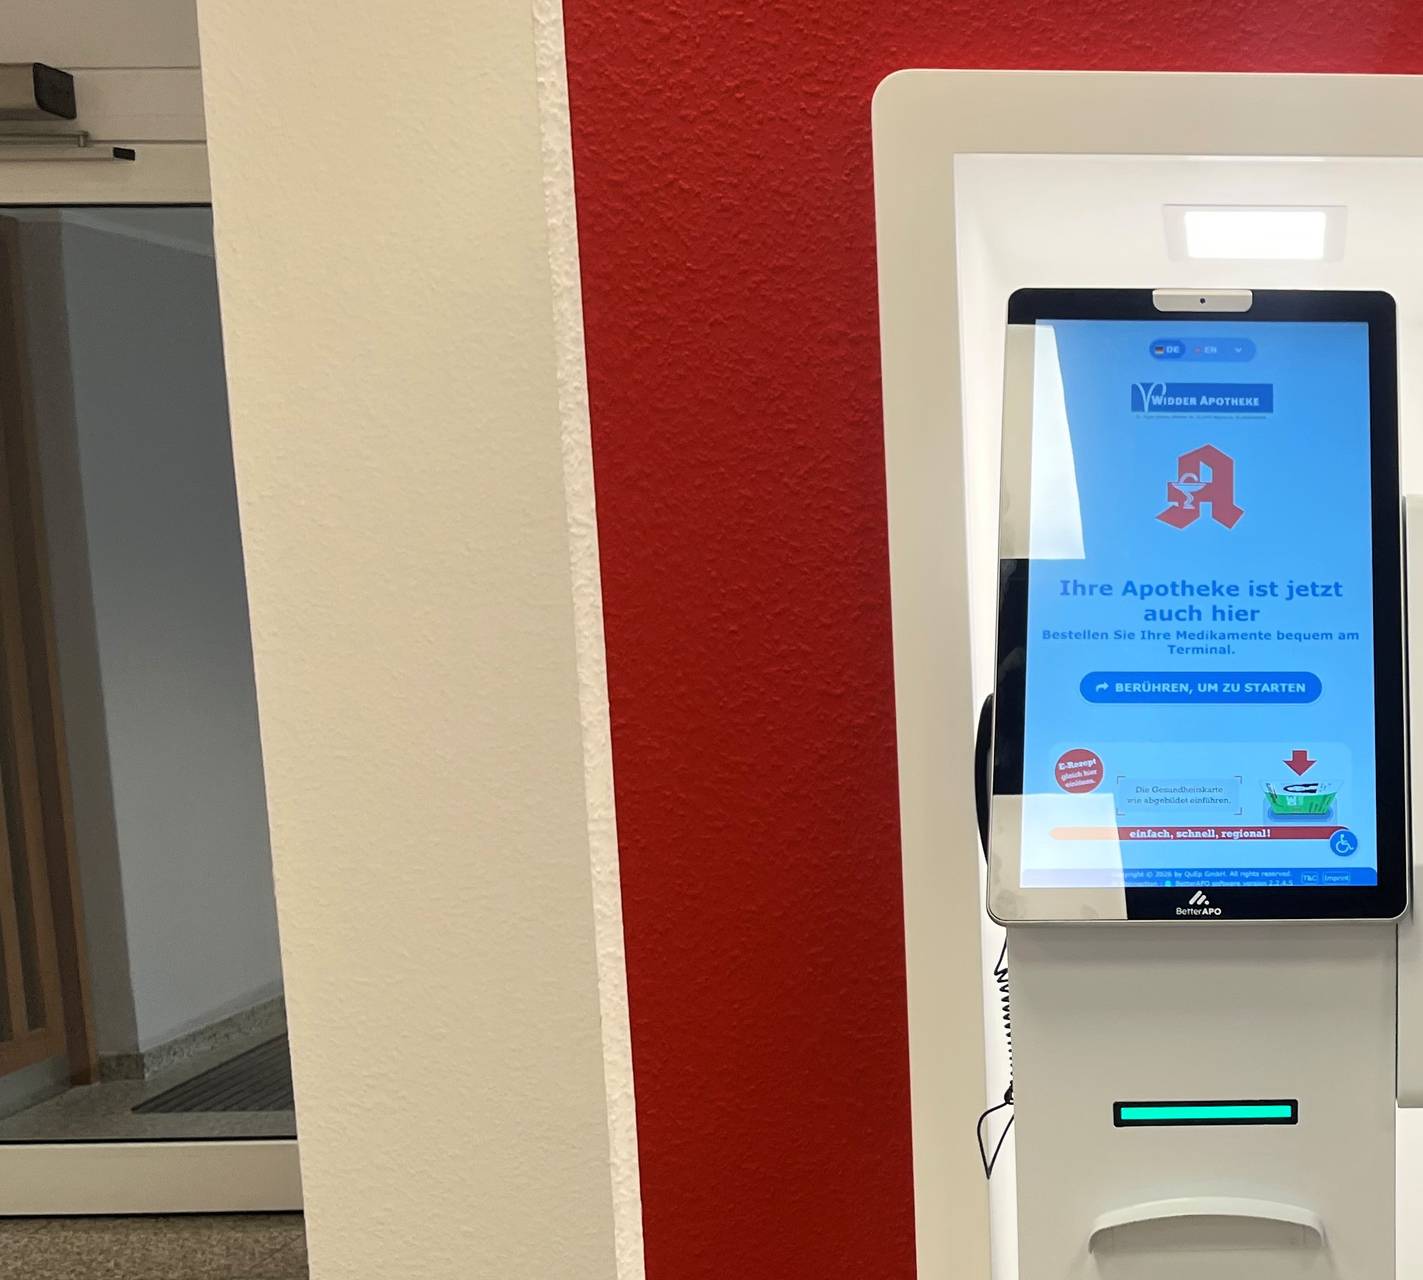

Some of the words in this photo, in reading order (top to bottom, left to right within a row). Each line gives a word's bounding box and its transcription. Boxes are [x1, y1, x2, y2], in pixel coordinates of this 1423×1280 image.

[1166, 346, 1180, 354] DE
[1200, 395, 1260, 406] APOTHEKE
[1059, 579, 1113, 596] Ihre
[1121, 579, 1240, 601] Apotheke
[1248, 579, 1279, 597] ist
[1285, 579, 1344, 601] jetzt
[1143, 604, 1203, 622] auch
[1212, 604, 1261, 622] hier
[1042, 629, 1109, 640] Bestellen
[1113, 630, 1136, 640] Sie
[1140, 630, 1172, 640] Ihre
[1176, 630, 1272, 641] Medikamente
[1276, 629, 1334, 642] bequem
[1338, 632, 1360, 641] am
[1167, 644, 1236, 655] Terminal.
[1115, 681, 1193, 695] BERÜHREN,
[1197, 683, 1219, 693] UM
[1222, 683, 1241, 693] ZU
[1244, 683, 1306, 693] STARTEN
[1135, 786, 1150, 794] Die
[1129, 829, 1174, 840] einfach,
[1176, 828, 1219, 839] schnell,
[1221, 828, 1271, 840] regional!
[1175, 907, 1222, 916] BetterAPO
